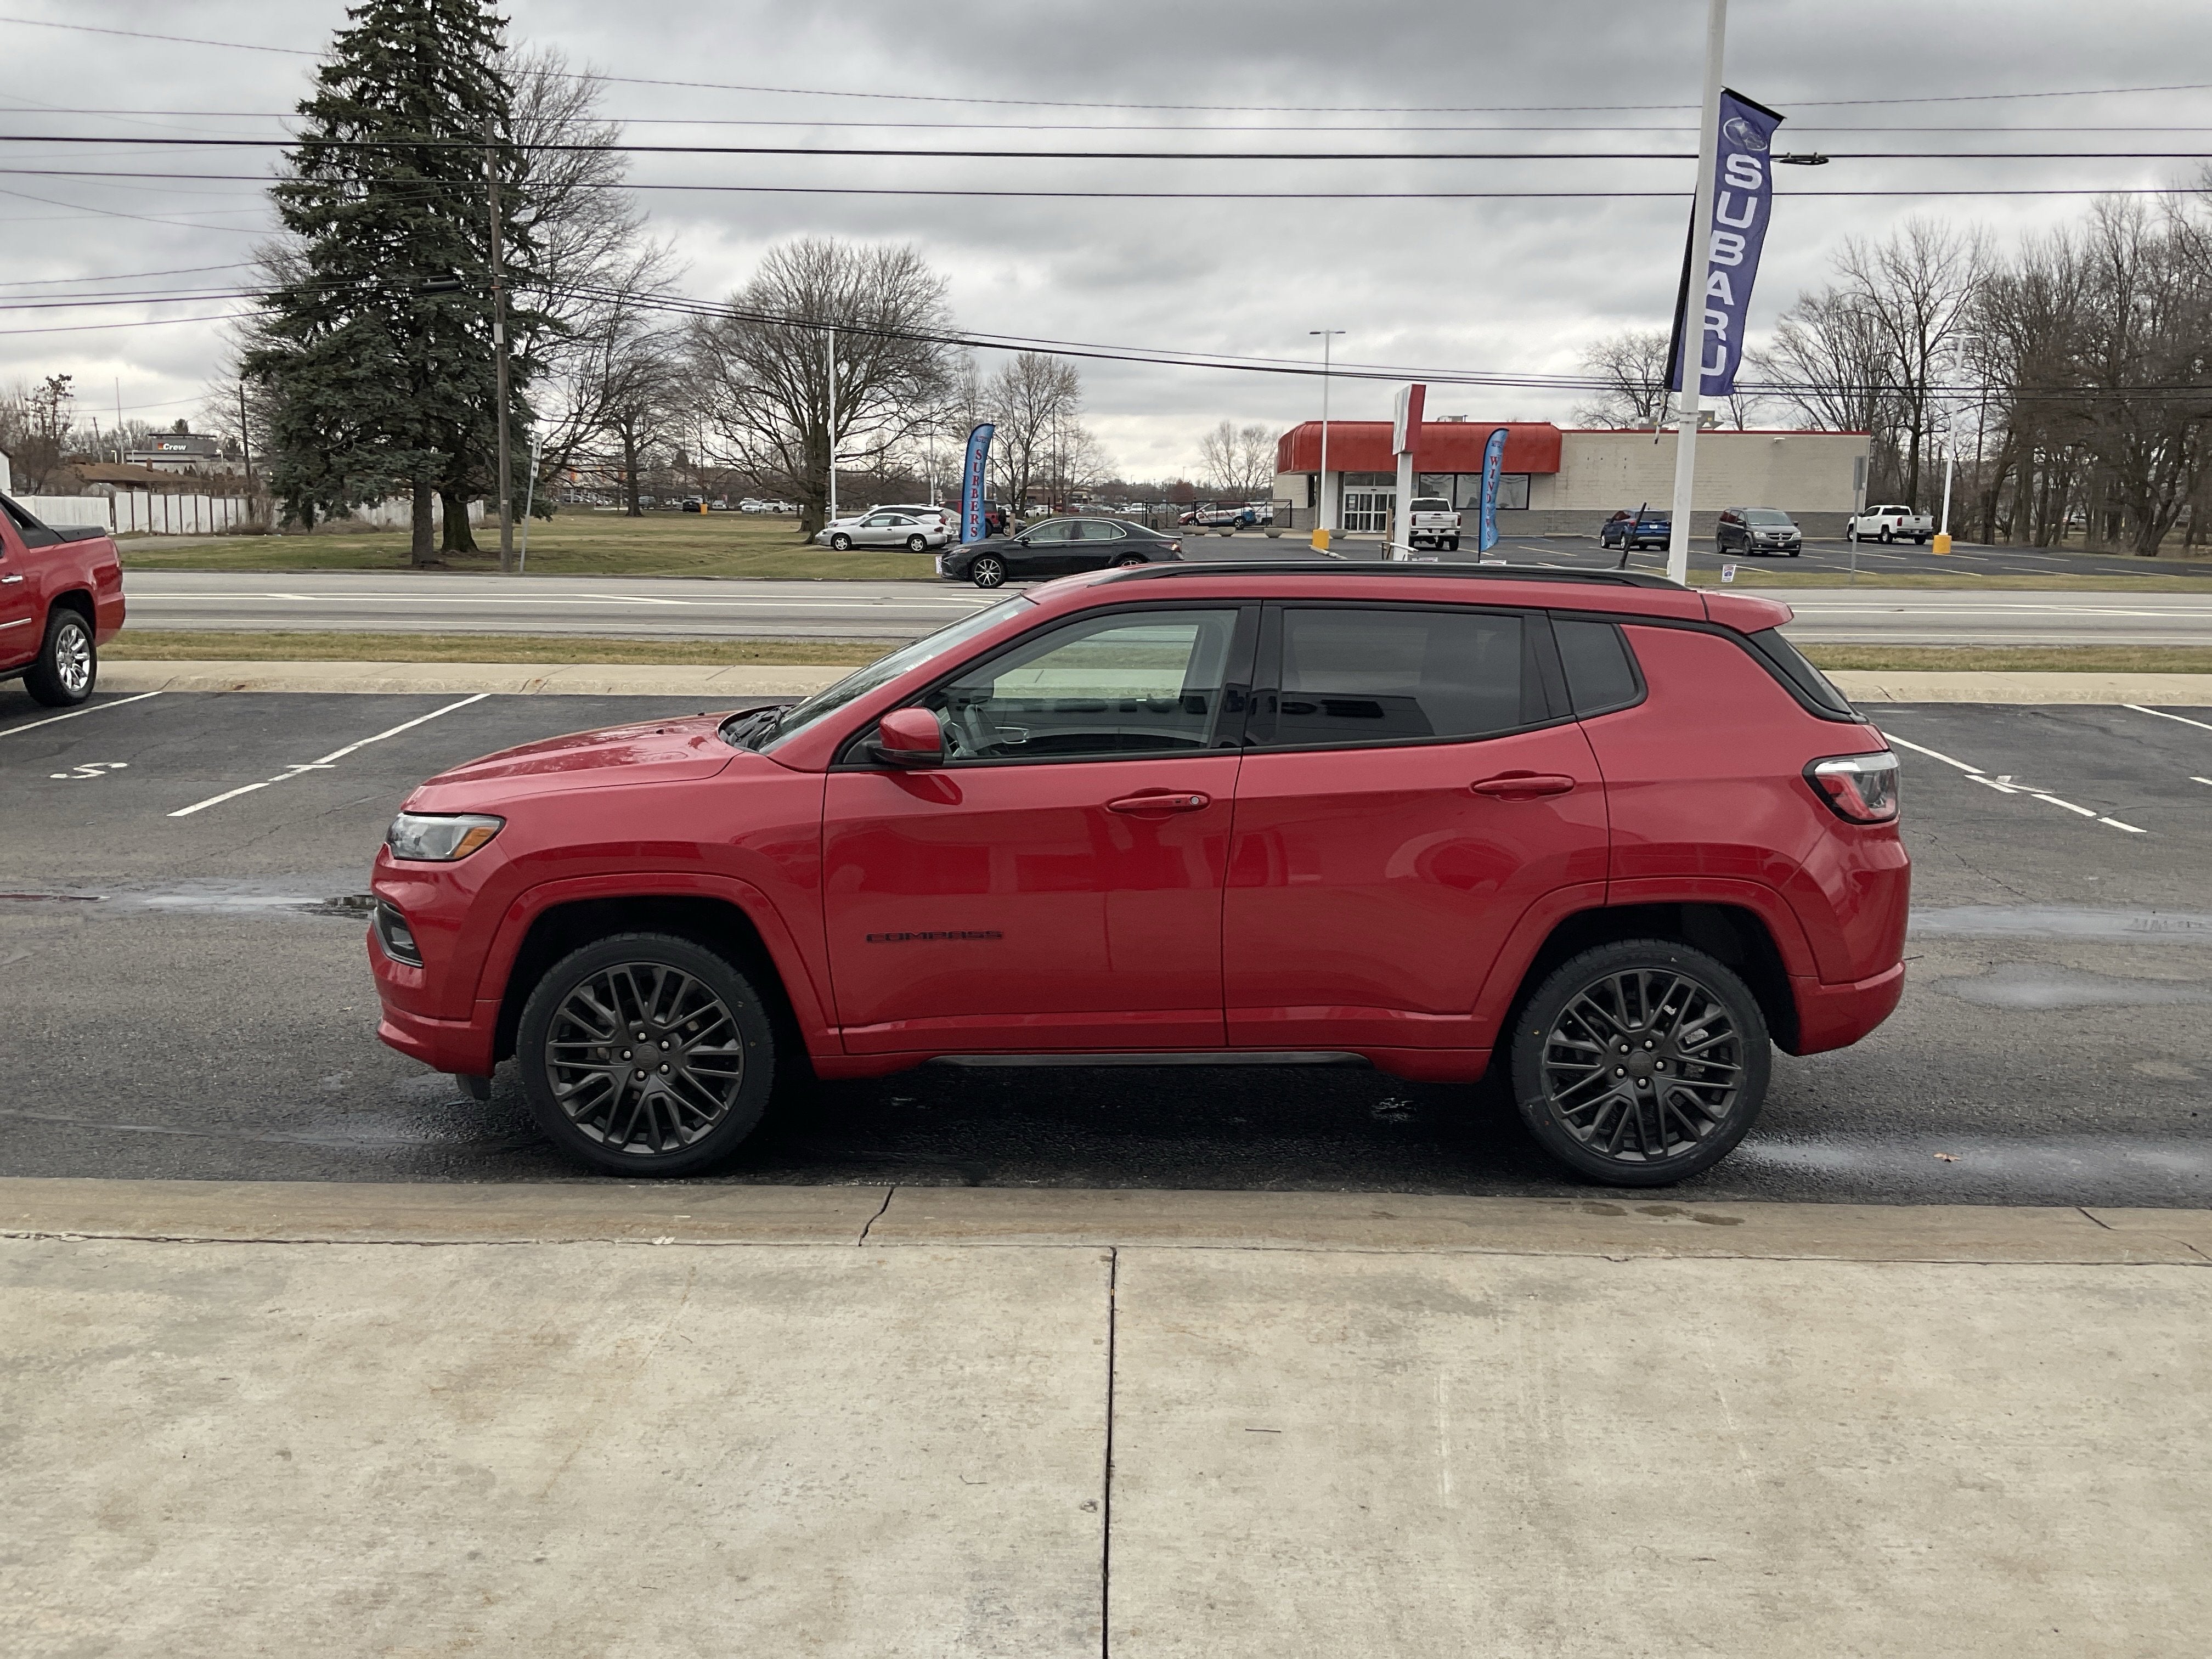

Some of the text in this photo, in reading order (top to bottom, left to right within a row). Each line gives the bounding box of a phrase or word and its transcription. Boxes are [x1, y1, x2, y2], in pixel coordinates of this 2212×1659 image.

[1700, 153, 1762, 376] SUBARU
[969, 449, 982, 537] SURBERS
[866, 931, 1003, 942] COMPASS
